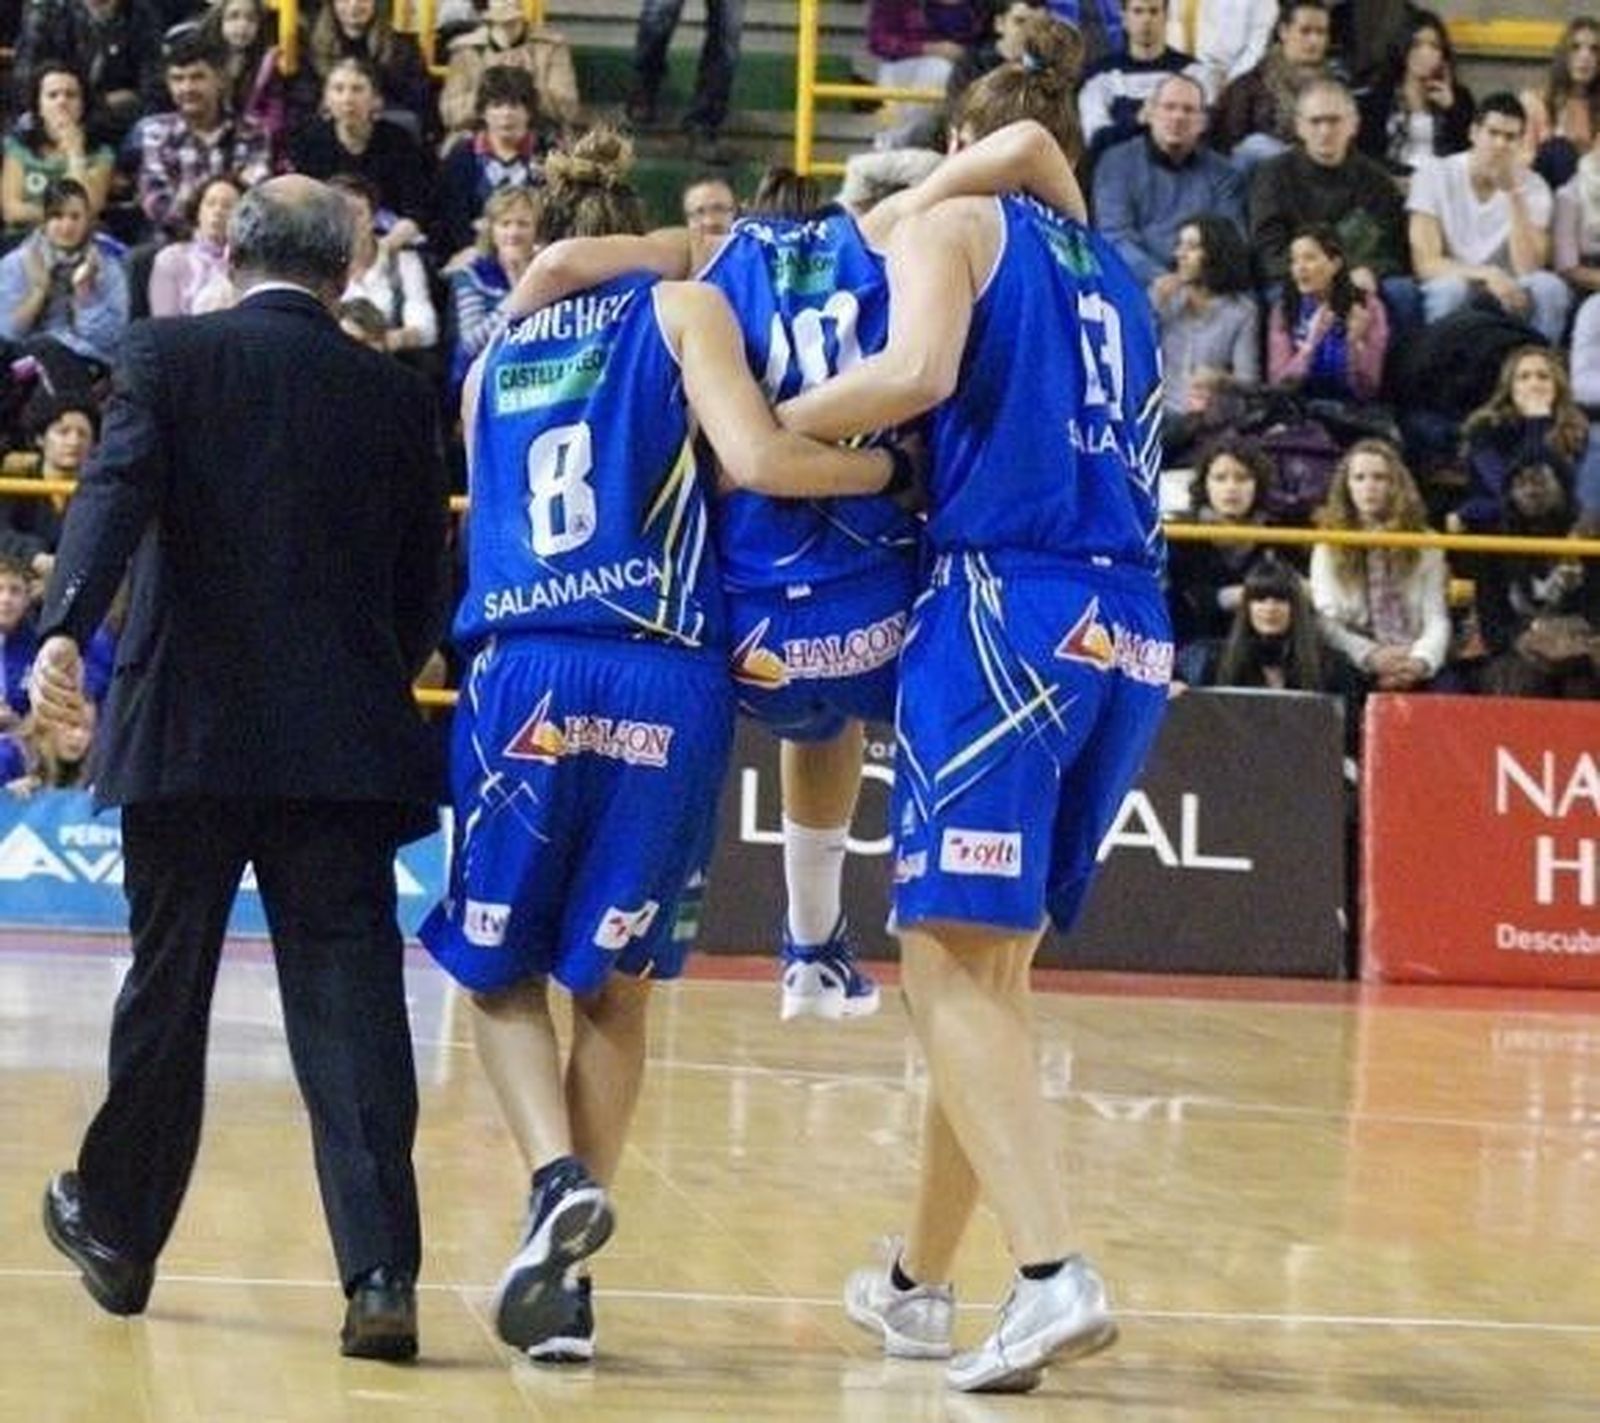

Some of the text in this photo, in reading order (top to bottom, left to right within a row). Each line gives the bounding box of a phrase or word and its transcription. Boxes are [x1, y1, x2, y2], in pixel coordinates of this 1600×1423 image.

[528, 420, 596, 557] 8
[484, 556, 665, 622] SALAMANCA
[783, 611, 907, 669] HALCON
